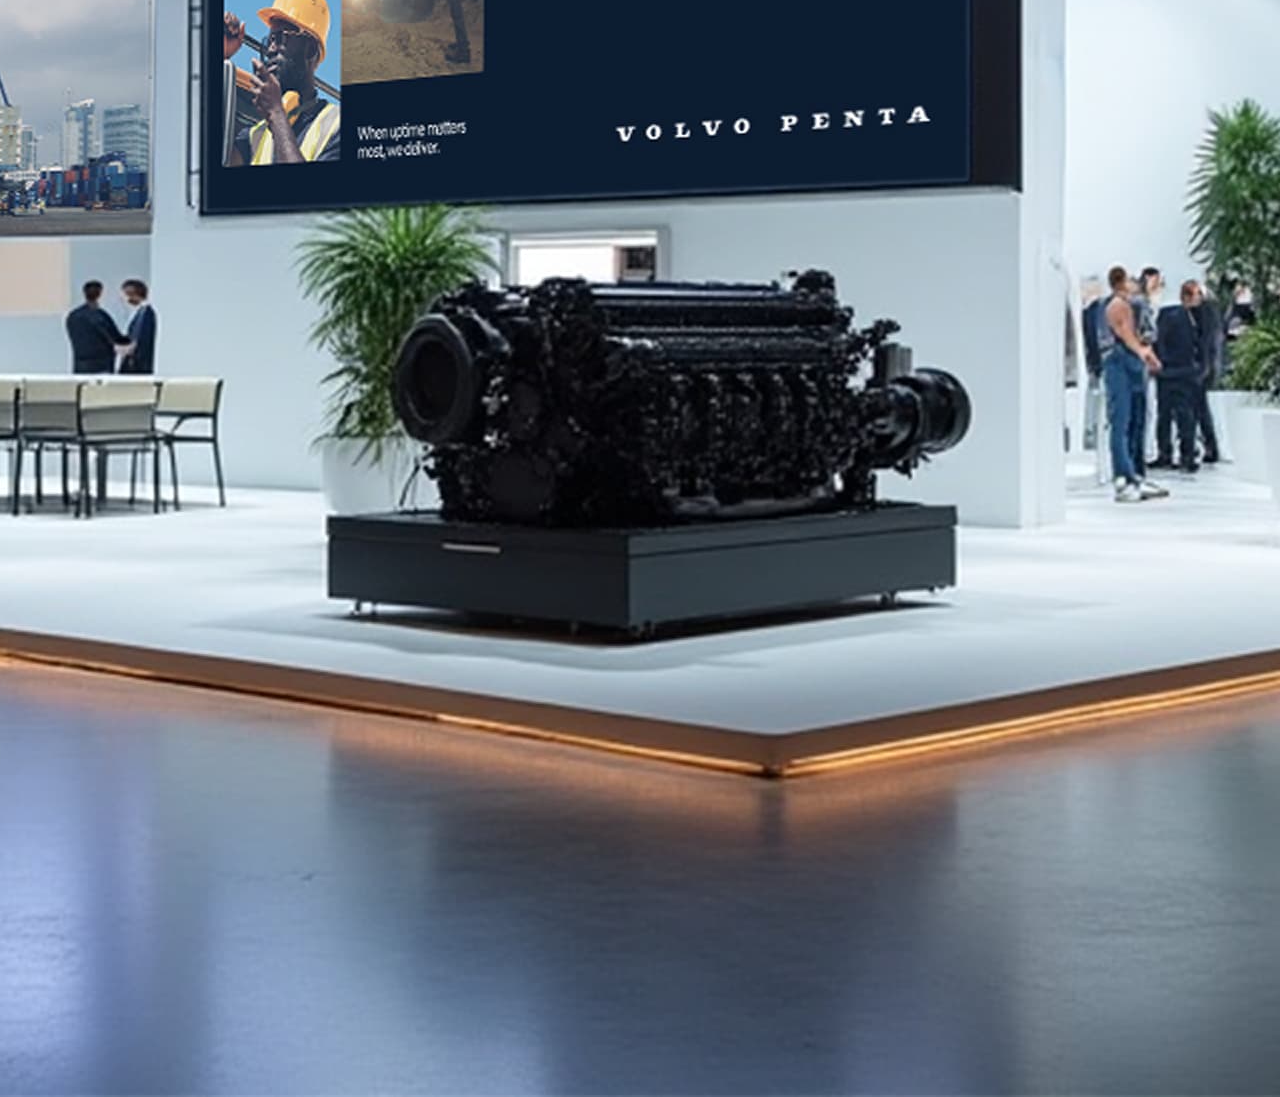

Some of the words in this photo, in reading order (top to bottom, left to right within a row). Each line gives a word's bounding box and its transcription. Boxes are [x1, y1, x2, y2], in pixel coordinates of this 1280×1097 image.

[357, 125, 388, 140] When
[389, 122, 426, 142] uptime
[427, 121, 467, 137] matters
[616, 117, 751, 142] VOLVO
[780, 106, 930, 132] PENTA
[357, 144, 387, 161] most,
[386, 145, 403, 157] we
[403, 140, 441, 157] deliver.
